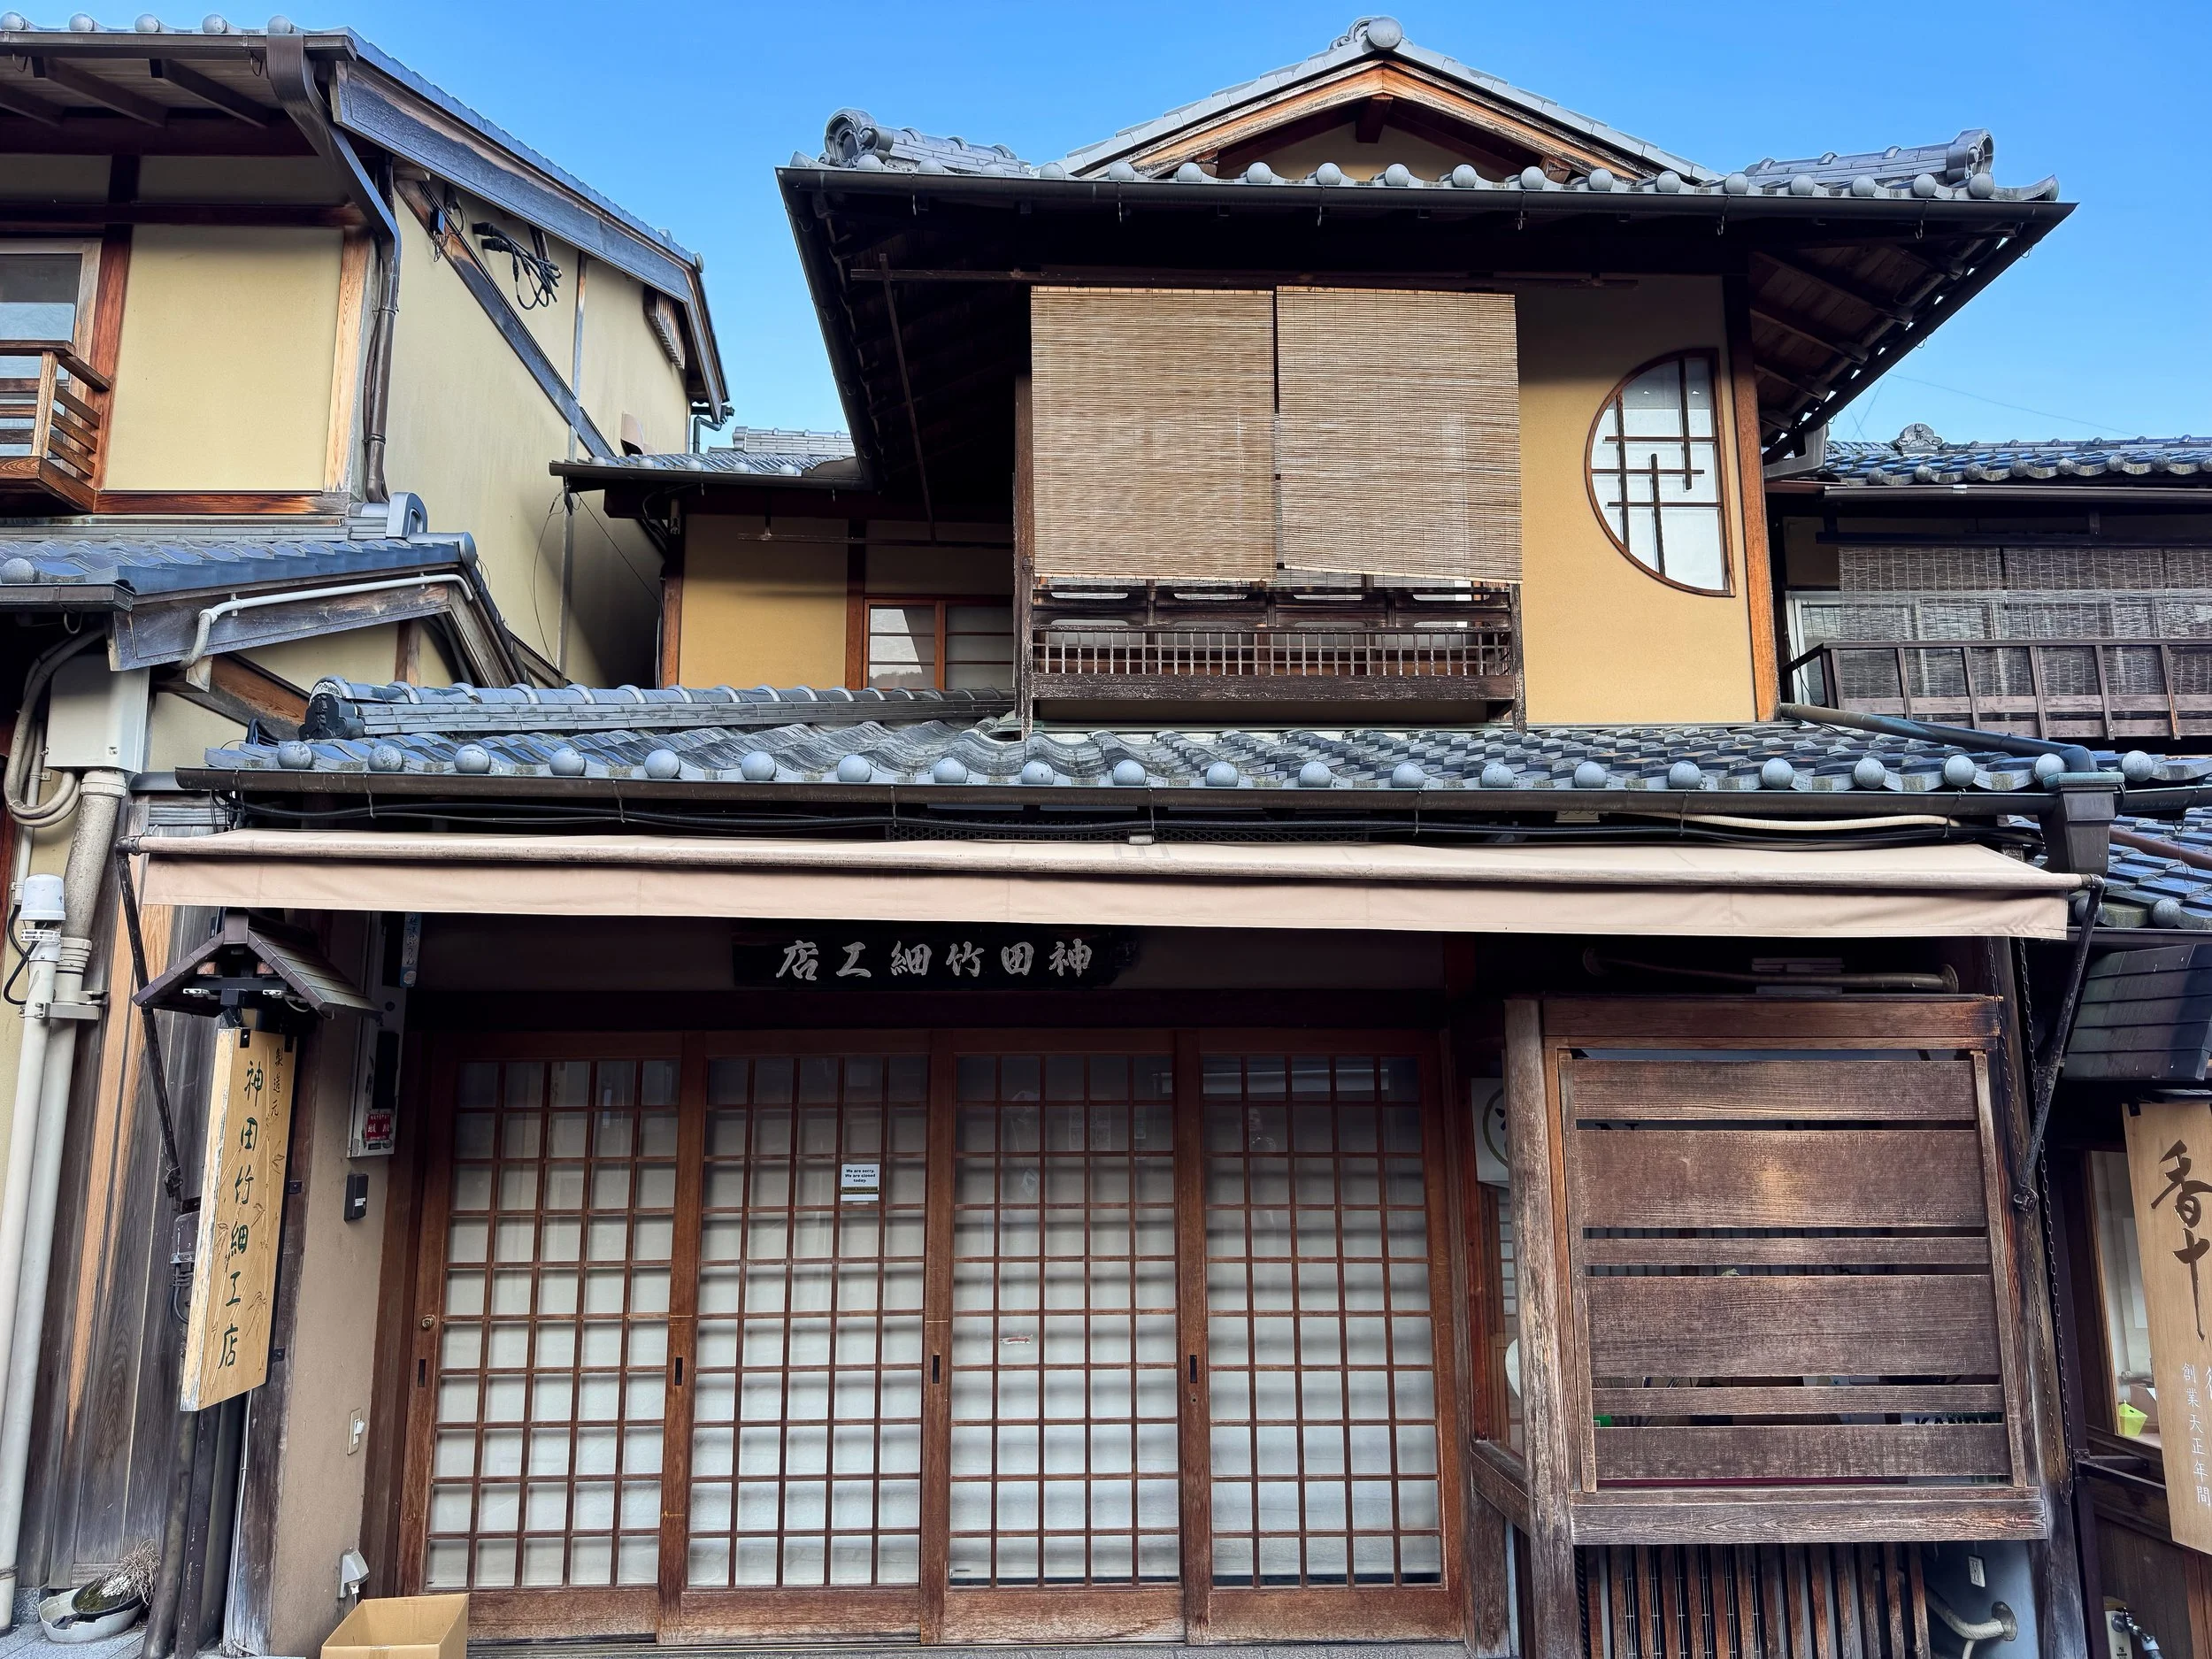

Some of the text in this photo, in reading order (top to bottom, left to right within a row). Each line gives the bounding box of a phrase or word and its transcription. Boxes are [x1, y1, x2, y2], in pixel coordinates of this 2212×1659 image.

[218, 1060, 265, 1370] 神田竹細工店
[2182, 1362, 2211, 1509] 創業天正年間
